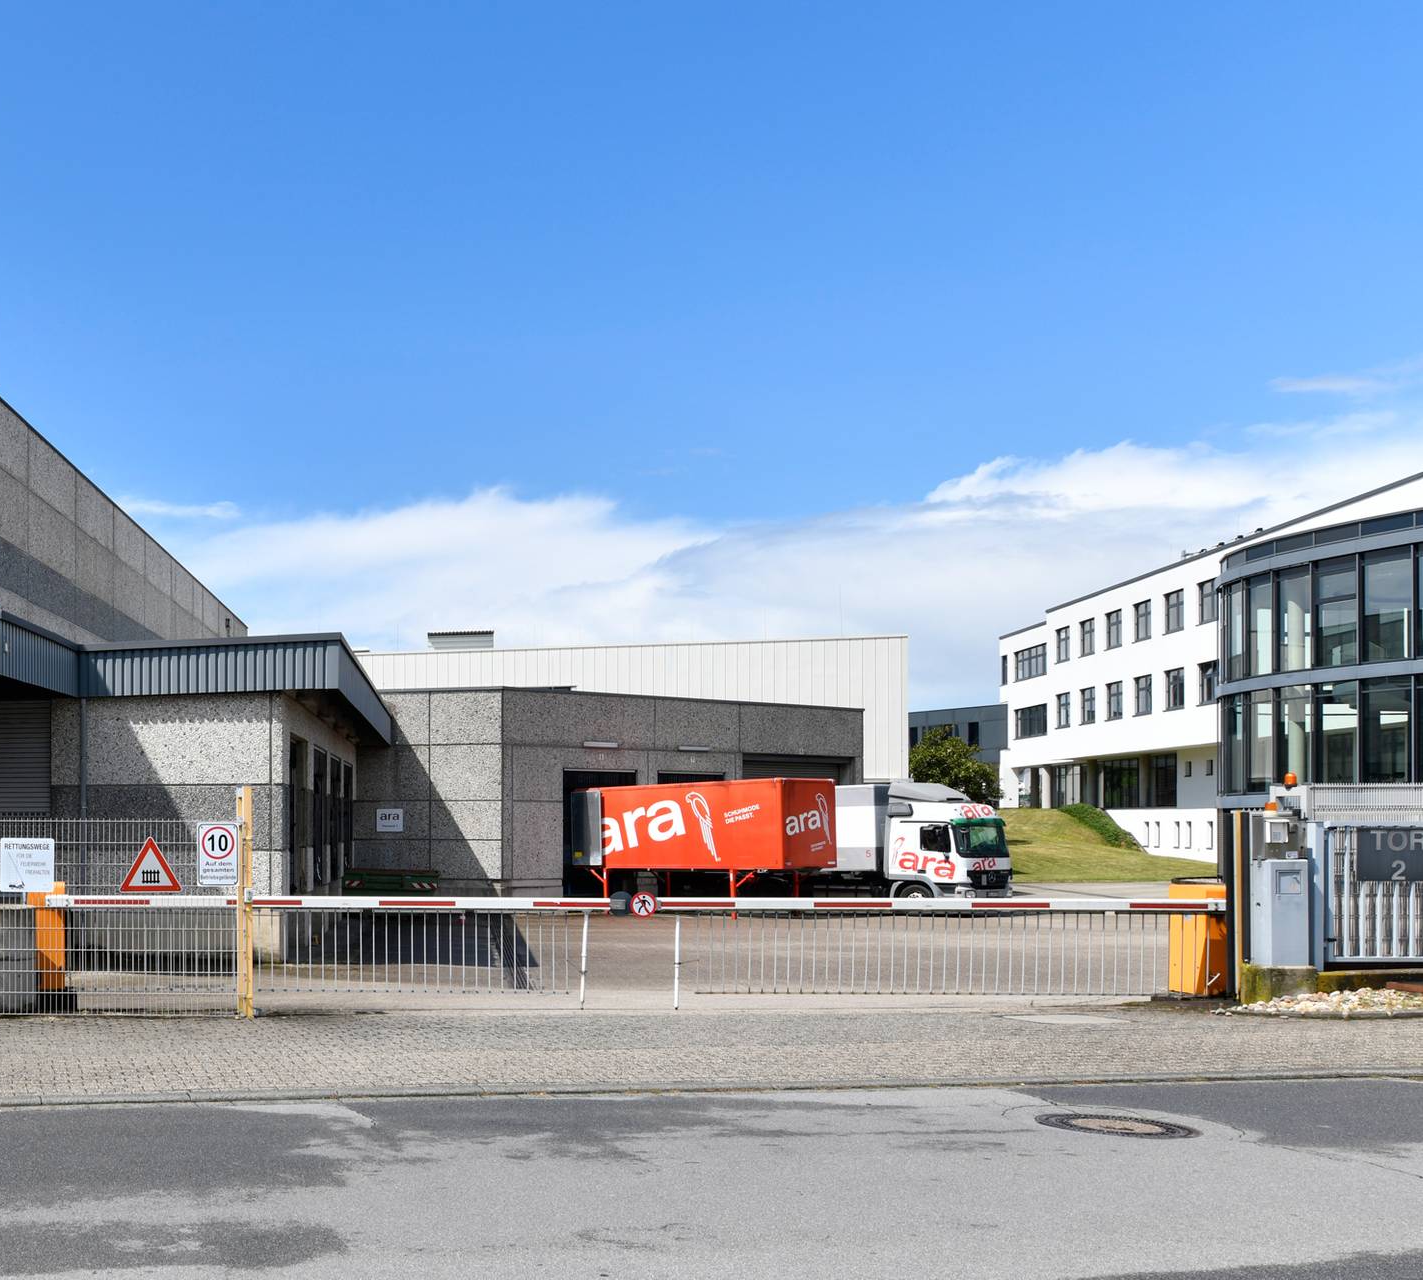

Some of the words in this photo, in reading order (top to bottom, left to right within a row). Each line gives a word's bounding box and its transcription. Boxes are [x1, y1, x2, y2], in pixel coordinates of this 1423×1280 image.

[380, 813, 400, 821] ara
[961, 803, 993, 819] ara
[785, 809, 821, 836] ara
[208, 834, 228, 852] 10
[899, 851, 957, 880] ara
[972, 857, 997, 872] ara
[1391, 860, 1406, 880] 2
